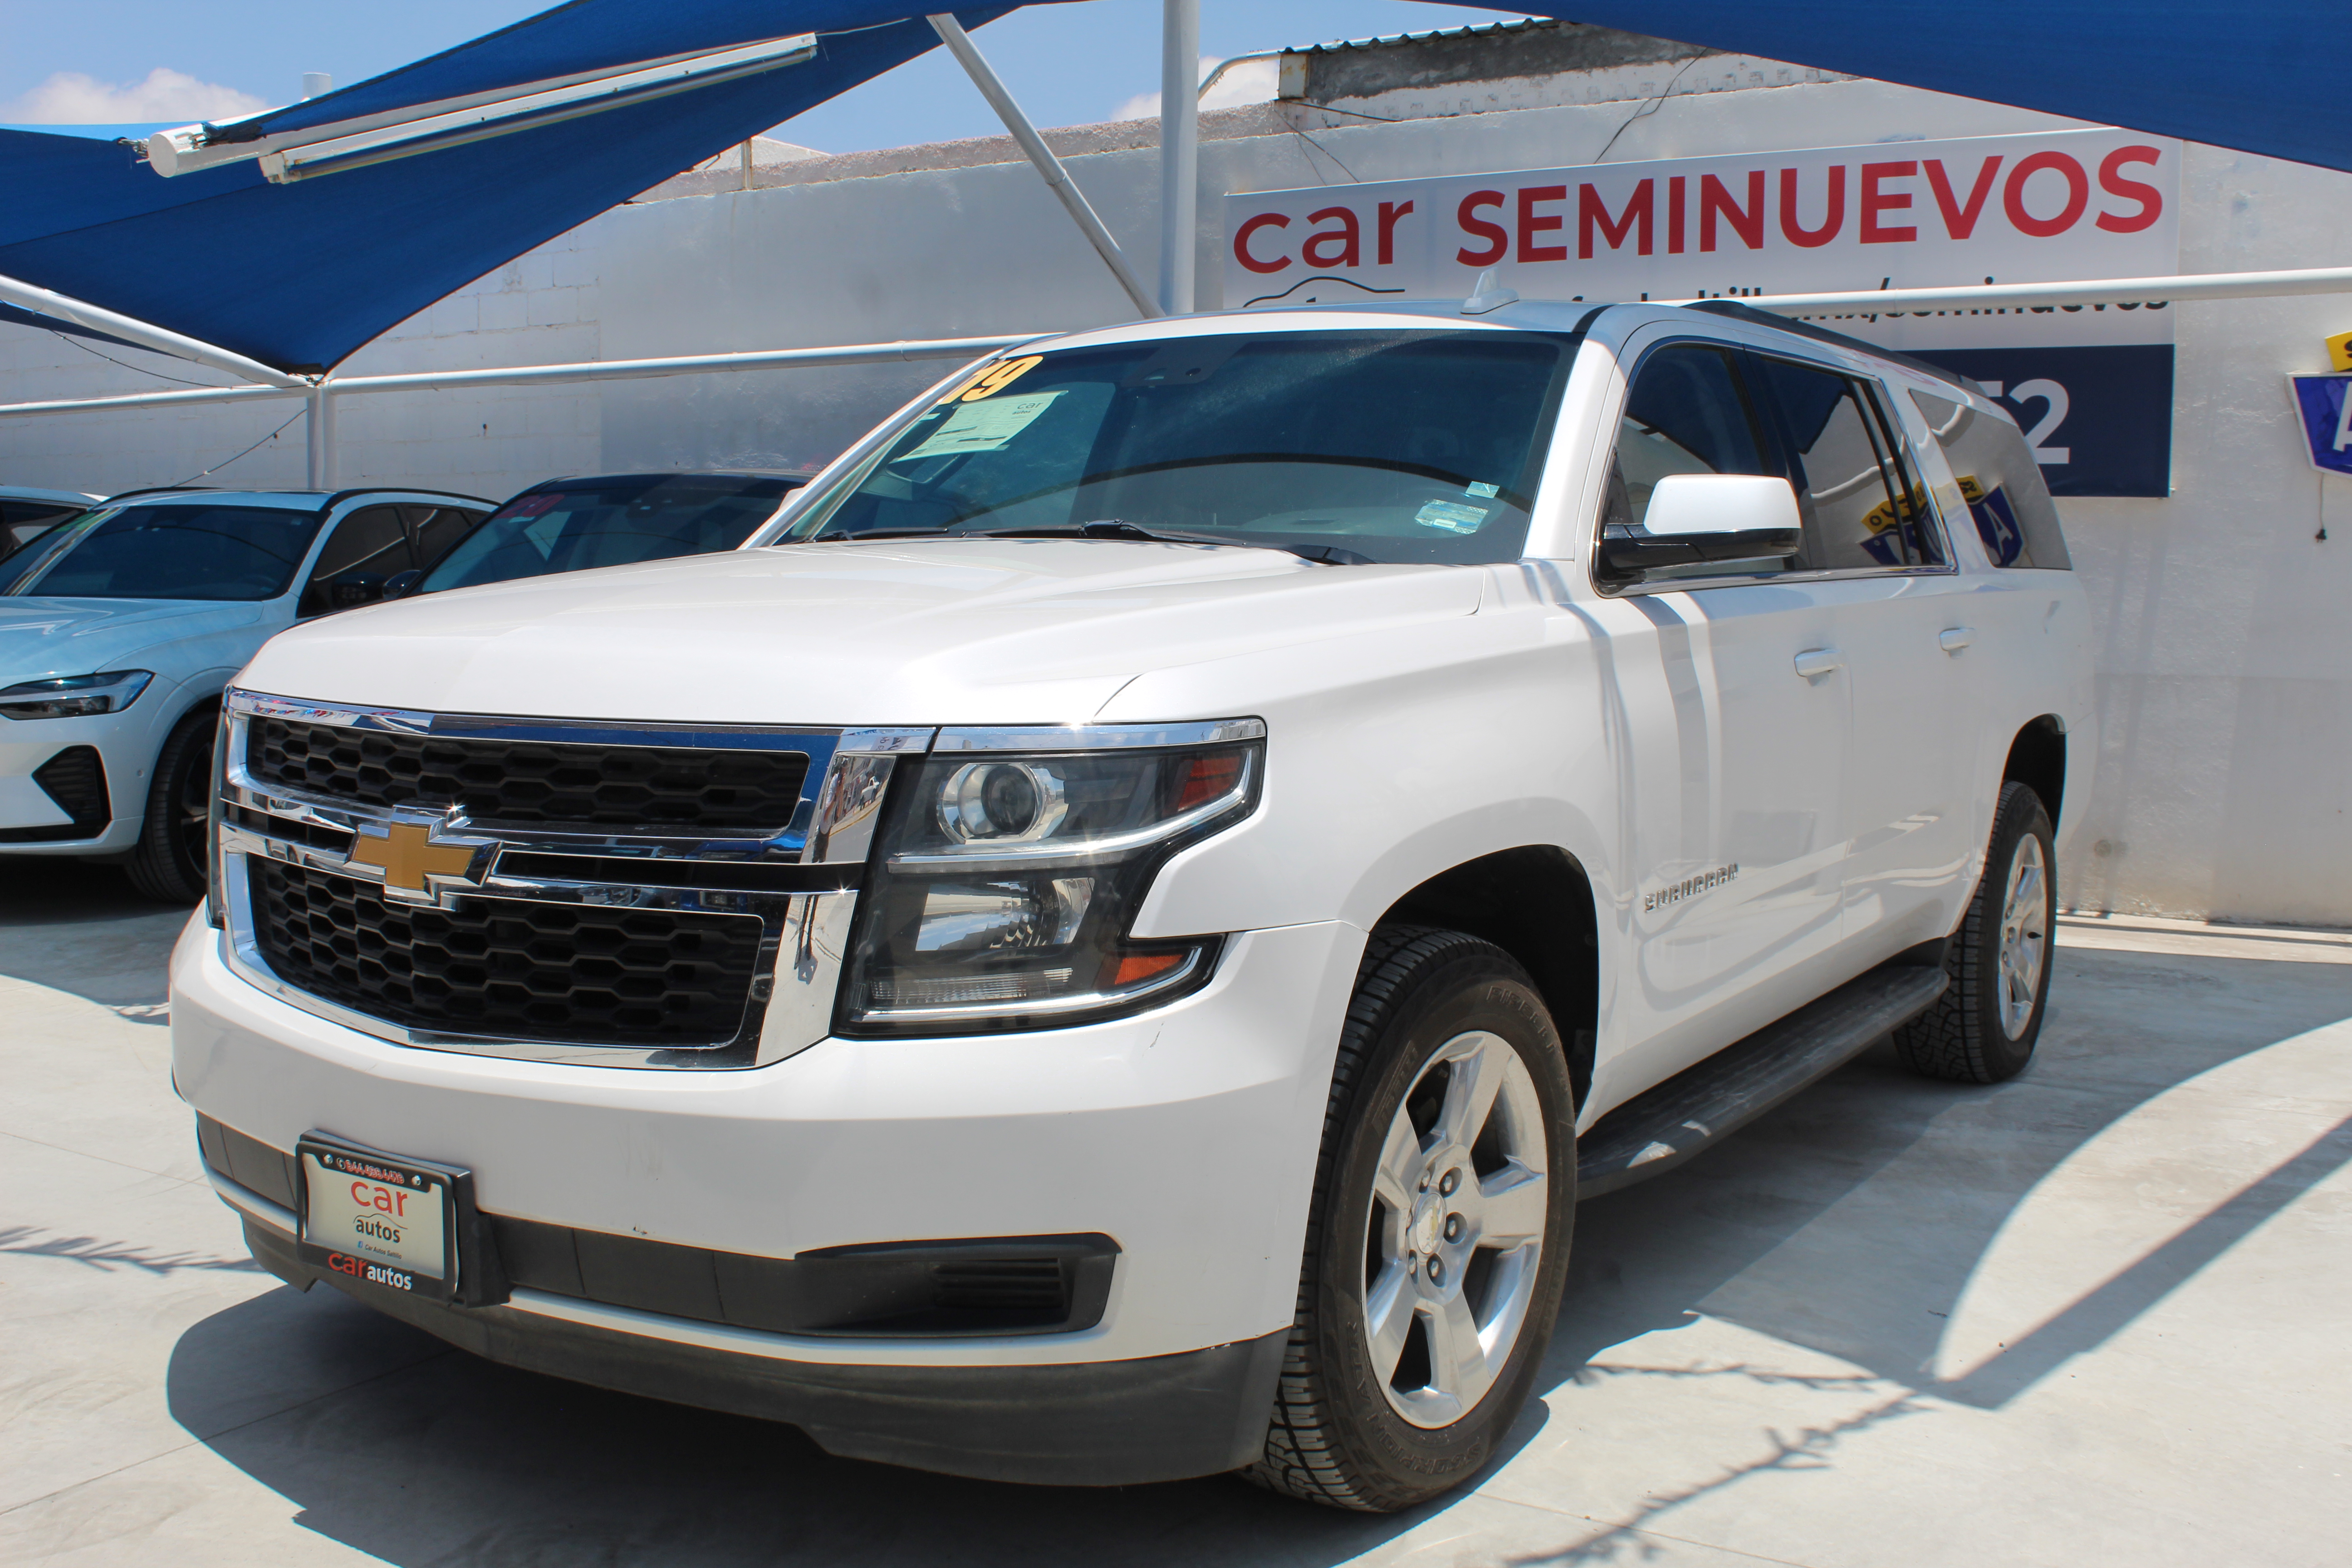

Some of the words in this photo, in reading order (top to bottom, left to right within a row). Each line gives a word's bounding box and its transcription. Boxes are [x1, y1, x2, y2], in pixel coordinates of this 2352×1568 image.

[1233, 199, 1414, 274] car
[1456, 145, 2163, 268] SEMINUEVOS
[1016, 401, 1044, 410] car
[1645, 863, 1739, 914] SUBURBAN
[350, 1181, 408, 1217] car
[357, 1219, 401, 1243] autos
